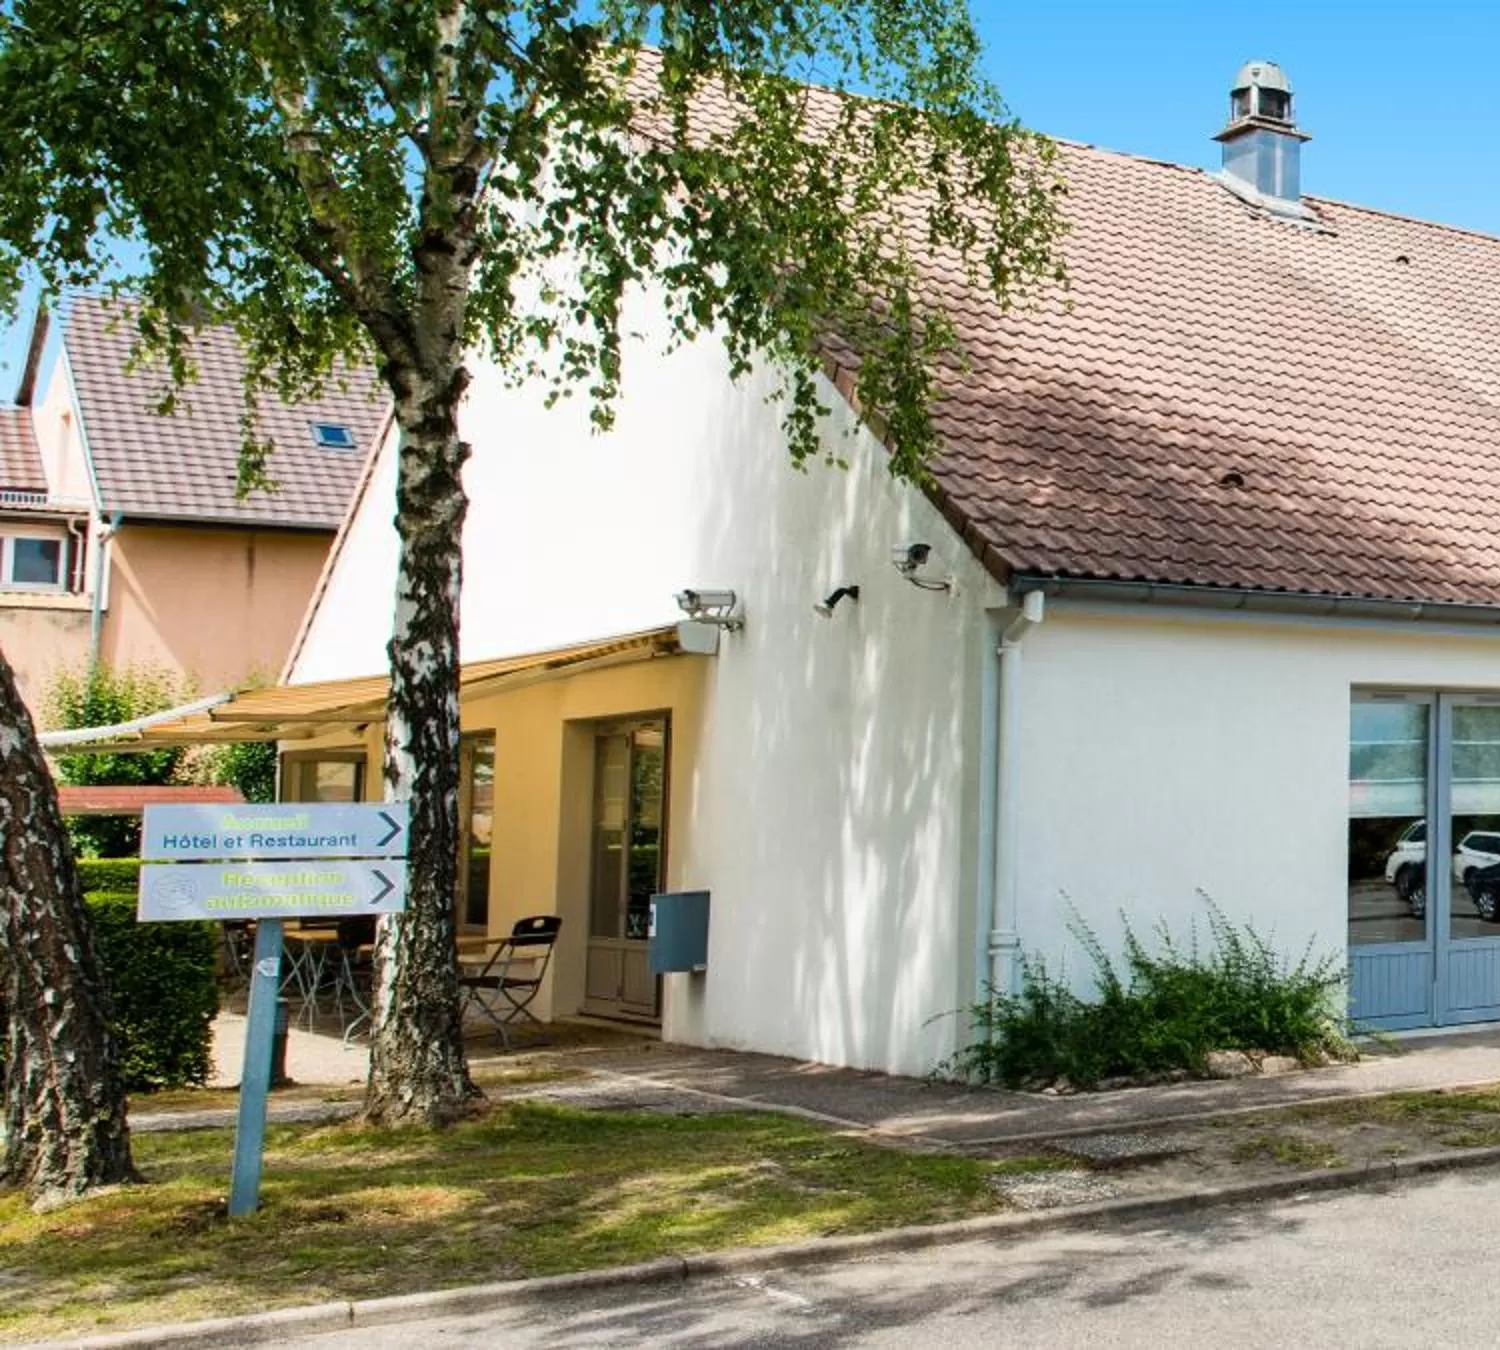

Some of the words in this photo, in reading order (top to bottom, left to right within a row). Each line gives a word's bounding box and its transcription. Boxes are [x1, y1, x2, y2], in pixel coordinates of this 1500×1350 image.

[163, 833, 217, 849] Hôtel
[223, 834, 243, 849] et
[251, 832, 357, 848] Restaurant
